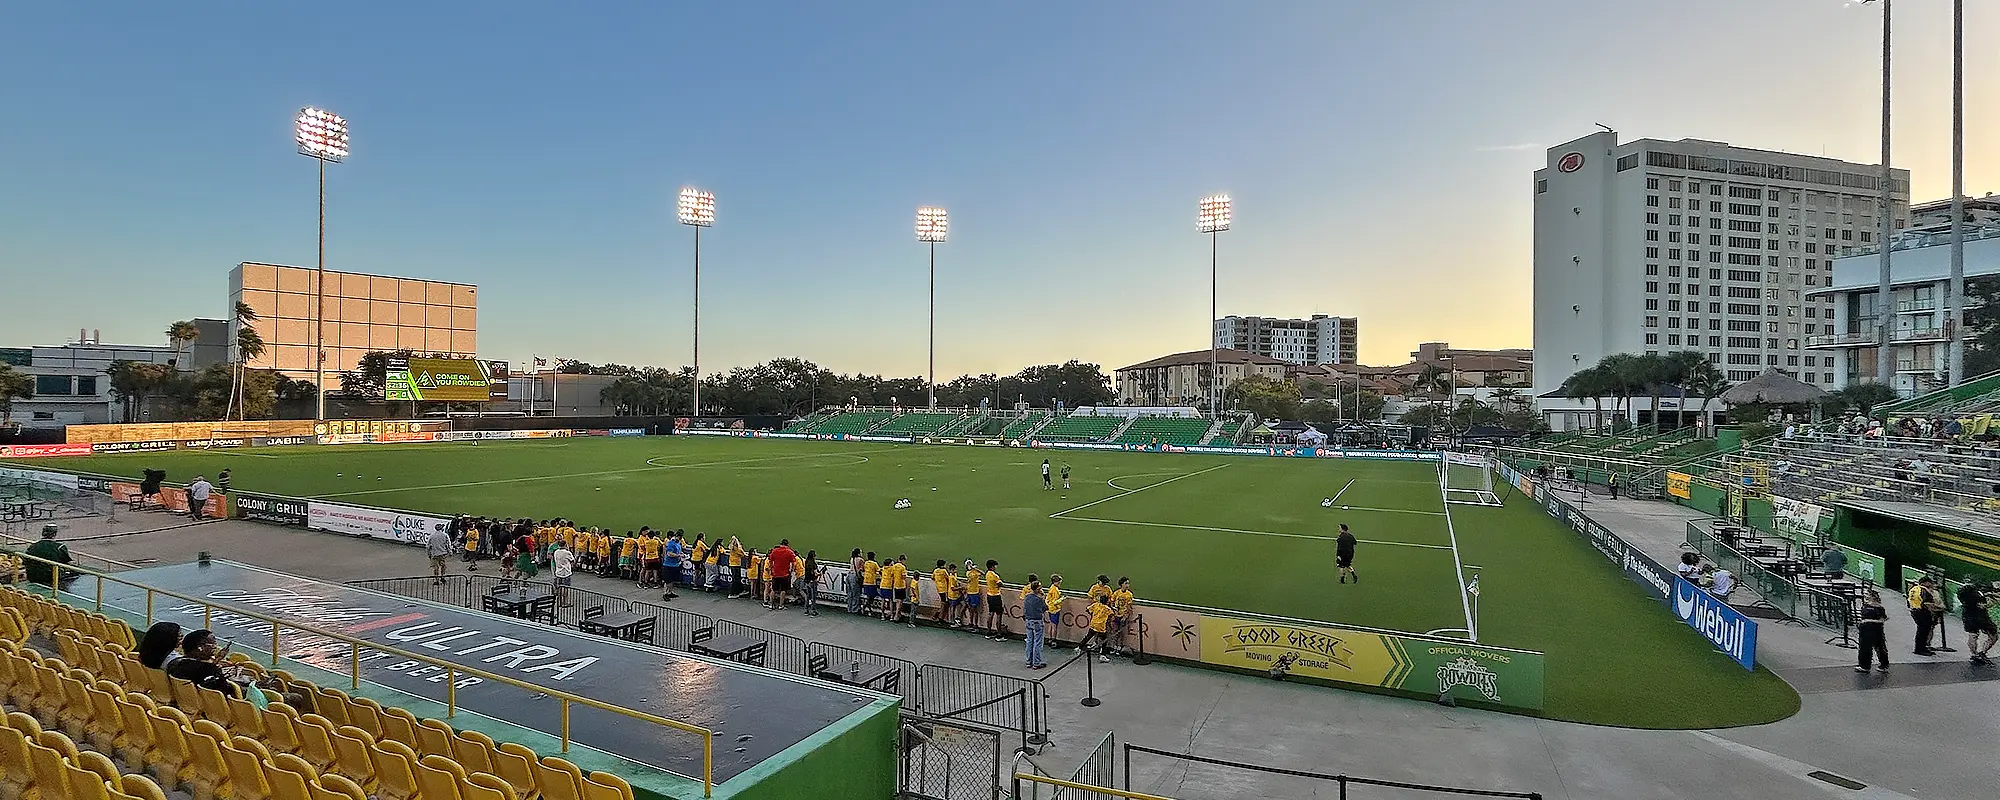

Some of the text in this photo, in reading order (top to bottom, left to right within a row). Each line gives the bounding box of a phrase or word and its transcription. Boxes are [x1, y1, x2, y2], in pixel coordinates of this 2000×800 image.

[435, 373, 458, 381] COME
[92, 443, 131, 451] COLONY
[140, 441, 177, 449] GRILL
[267, 437, 305, 446] JABIL
[237, 498, 308, 516] COLONY GRILL
[406, 518, 430, 543] DUKE ENERG
[1695, 593, 1745, 661] Webull
[385, 622, 600, 681] ULTRA
[1238, 628, 1339, 656] GOOD GREEK
[1246, 652, 1329, 670] MOVING STORAGE
[1428, 647, 1511, 664] OFFICIAL MOVERS
[385, 658, 484, 690] BEER
[1437, 666, 1498, 699] ROWDIES
